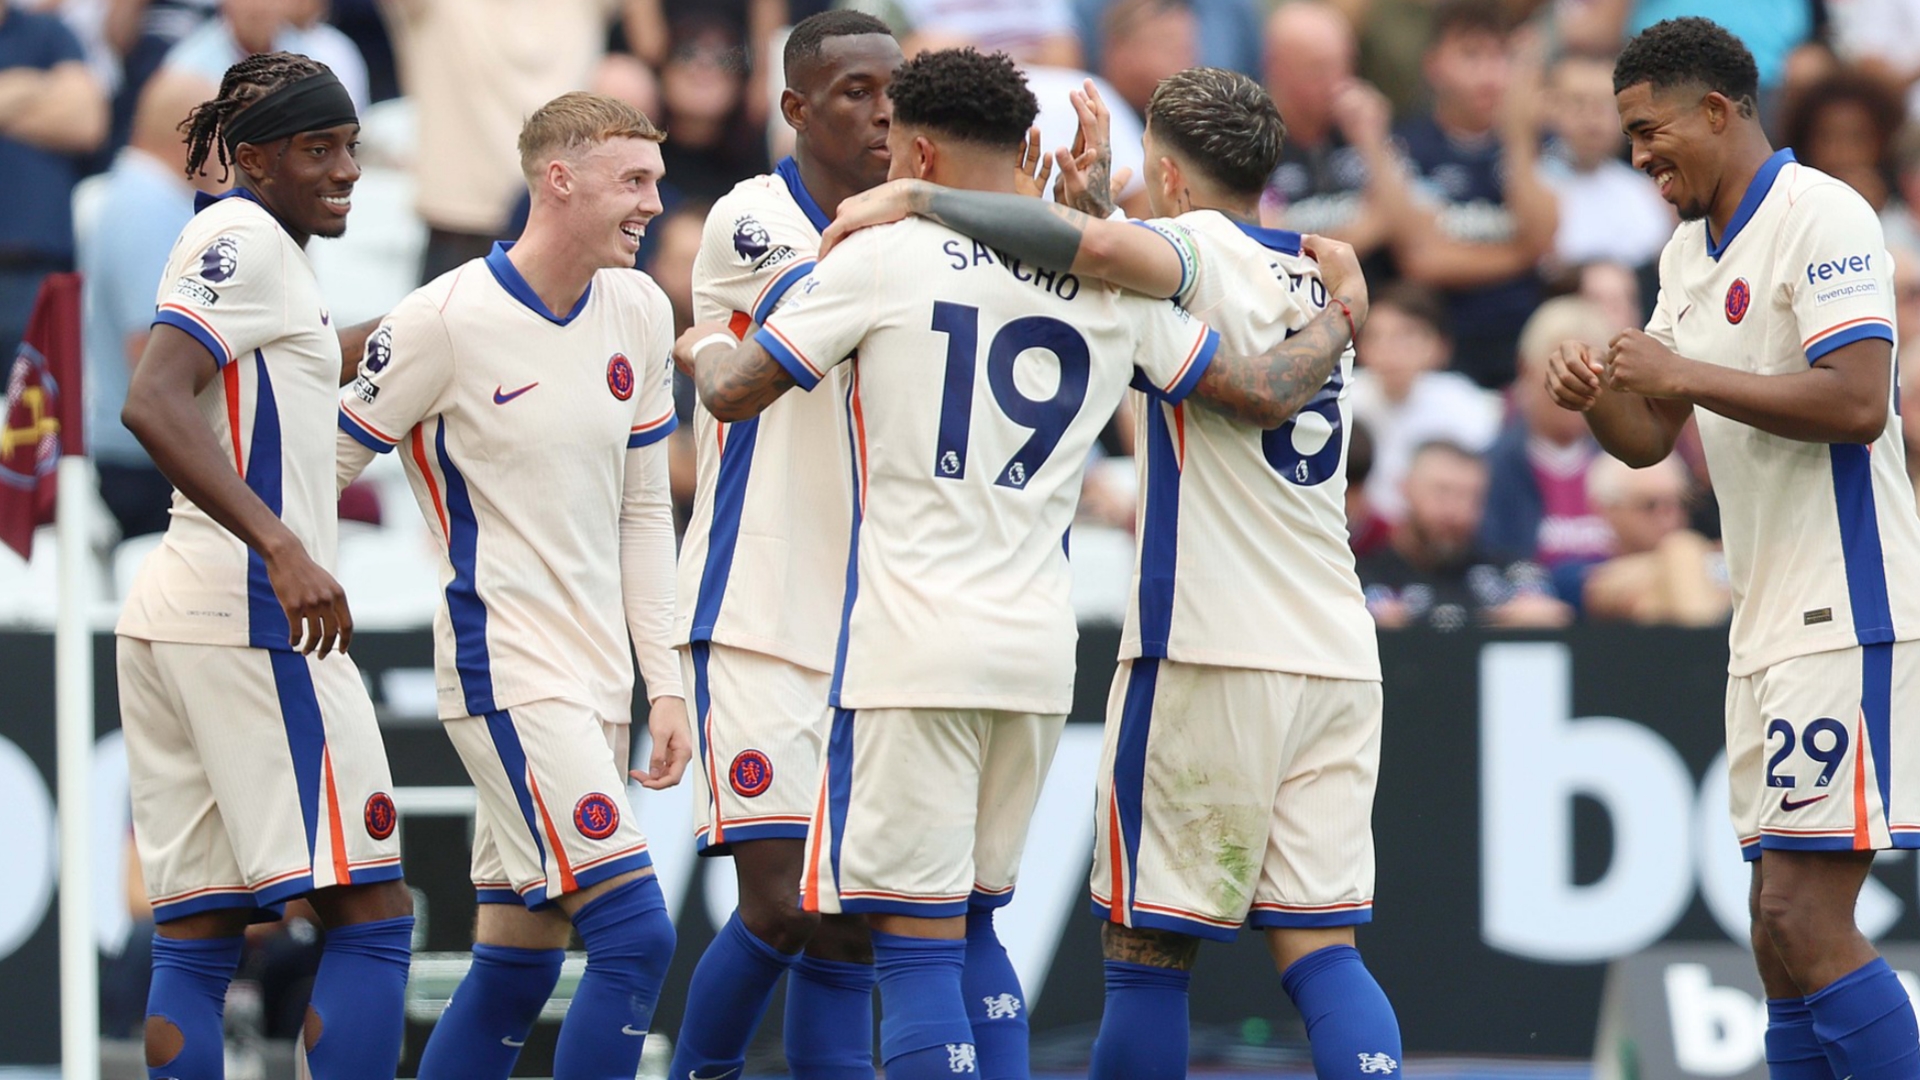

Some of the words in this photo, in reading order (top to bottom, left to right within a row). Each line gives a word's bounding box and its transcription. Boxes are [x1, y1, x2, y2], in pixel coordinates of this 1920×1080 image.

[1807, 254, 1871, 285] fever
[1816, 283, 1876, 303] feverup.com
[931, 300, 1092, 491] 19
[1766, 718, 1849, 788] 29
